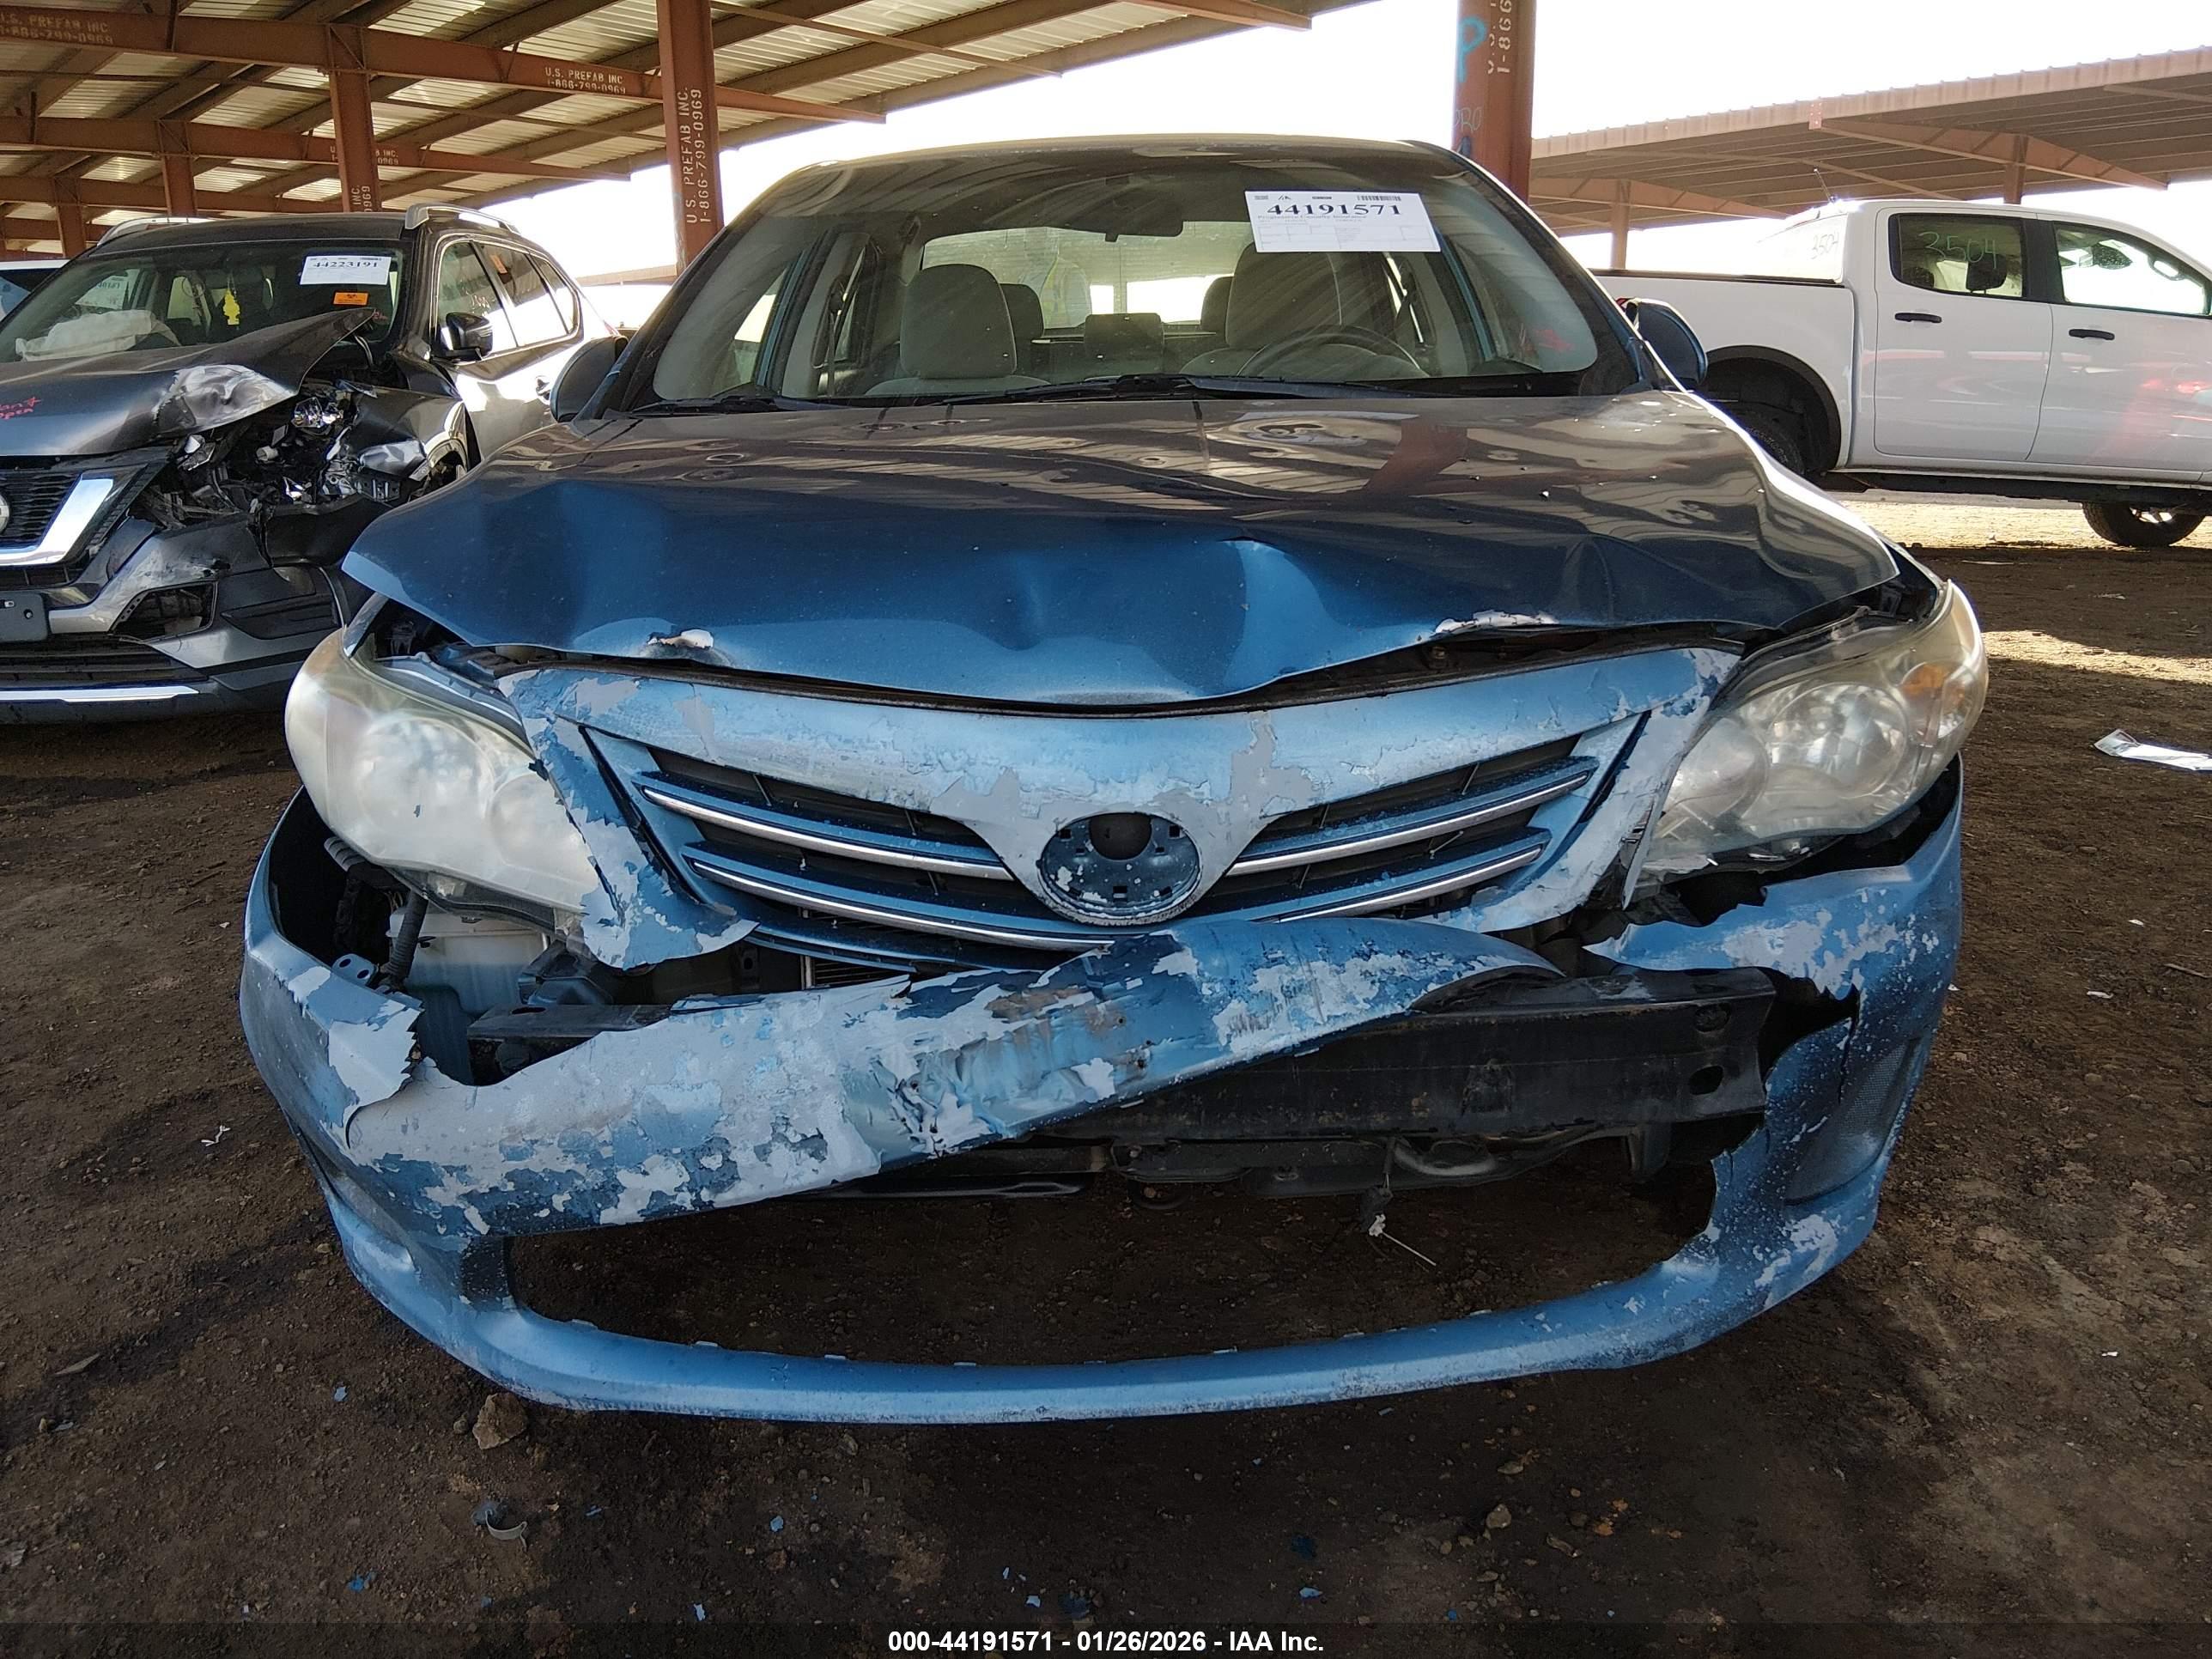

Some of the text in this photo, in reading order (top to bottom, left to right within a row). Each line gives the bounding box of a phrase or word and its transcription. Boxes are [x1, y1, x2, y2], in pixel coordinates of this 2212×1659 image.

[544, 67, 623, 84] U.S. PREFAB INC
[677, 87, 690, 117] INC.
[680, 125, 695, 185] PREFAB
[690, 88, 712, 223] 1-866-799-0969
[1267, 204, 1401, 216] 44191571
[1917, 231, 1997, 270] 3504
